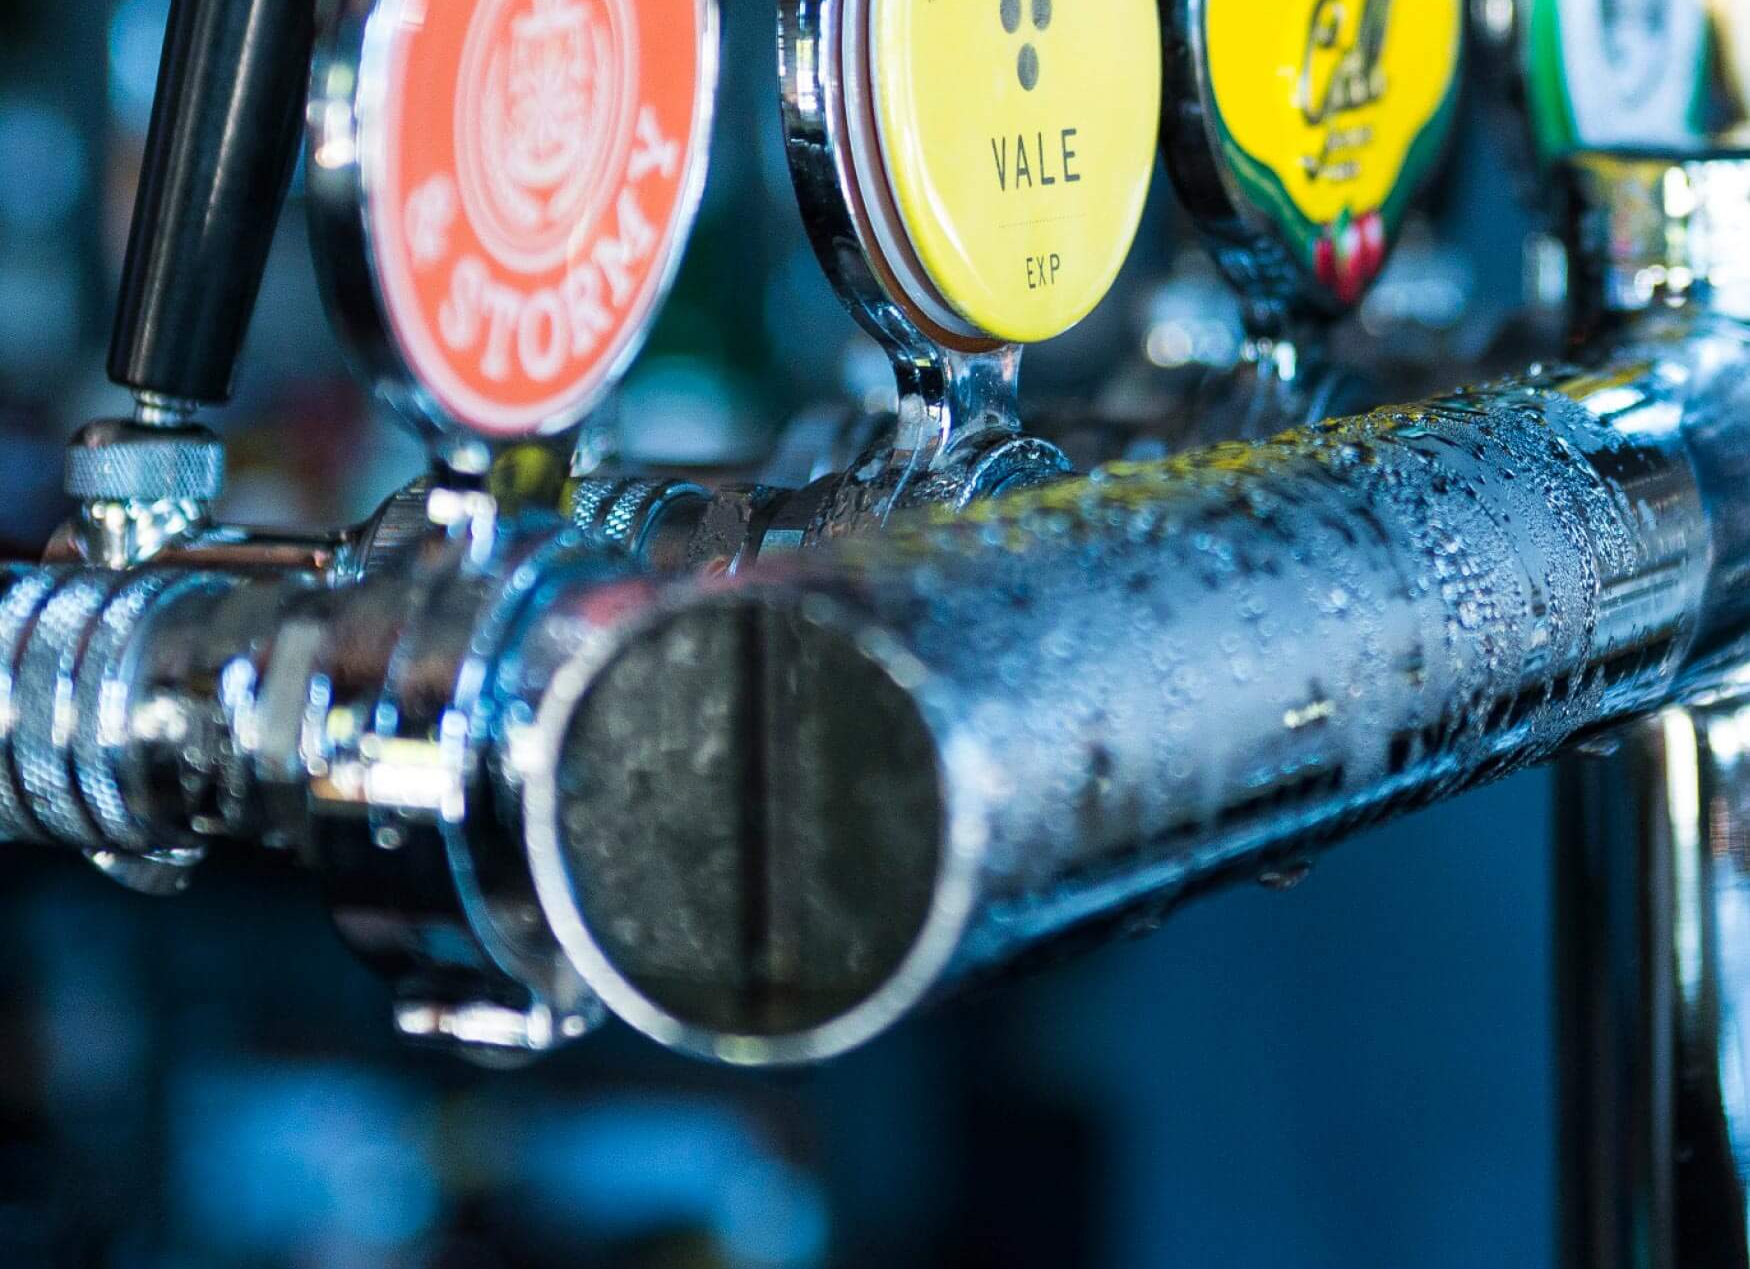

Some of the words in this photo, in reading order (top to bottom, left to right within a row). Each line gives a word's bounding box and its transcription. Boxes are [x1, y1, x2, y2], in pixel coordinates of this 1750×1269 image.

[991, 128, 1081, 192] VALE
[437, 105, 680, 382] STORMY
[1026, 253, 1061, 289] EXP
